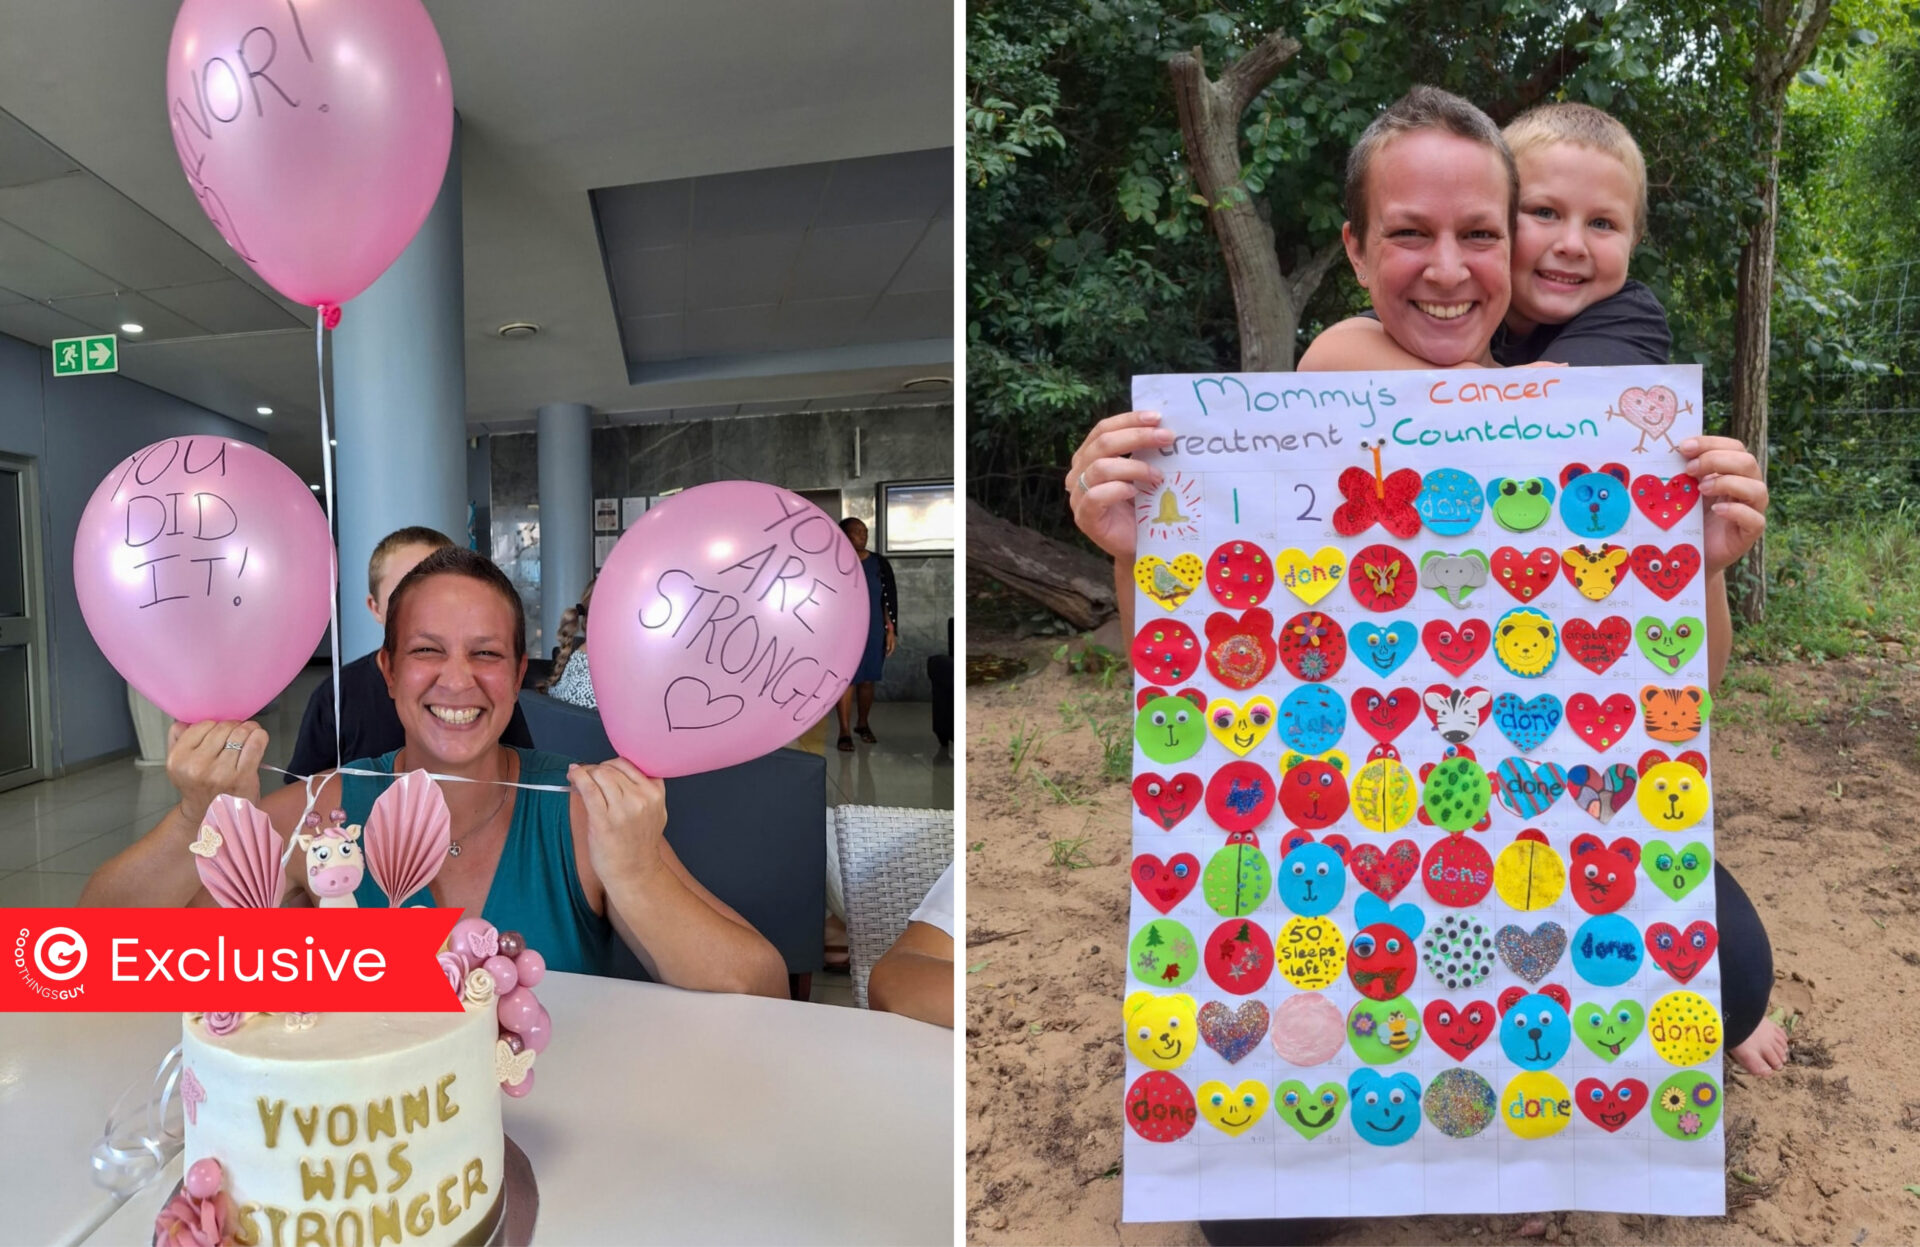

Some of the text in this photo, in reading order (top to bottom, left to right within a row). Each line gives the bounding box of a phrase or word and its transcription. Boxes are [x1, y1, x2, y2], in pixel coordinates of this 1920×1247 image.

[1192, 375, 1398, 428] Mommy's
[1391, 414, 1599, 447] Countdown
[110, 438, 227, 502] YOU
[124, 491, 239, 548] DID
[1293, 483, 1323, 522] 2
[1420, 493, 1483, 519] done
[763, 491, 861, 589] YOU
[132, 546, 250, 609] IT!
[716, 543, 838, 635] ARE
[1283, 563, 1343, 588] done
[1500, 702, 1561, 732] done
[1506, 772, 1563, 797] done
[1428, 855, 1489, 887] done
[1288, 924, 1323, 944] 50
[1651, 1016, 1719, 1045] done
[255, 1071, 461, 1150] YVONNE
[1131, 1086, 1198, 1127] done
[1508, 1089, 1572, 1120] done
[299, 1140, 414, 1203] WAS
[232, 1157, 490, 1247] STRONGER
